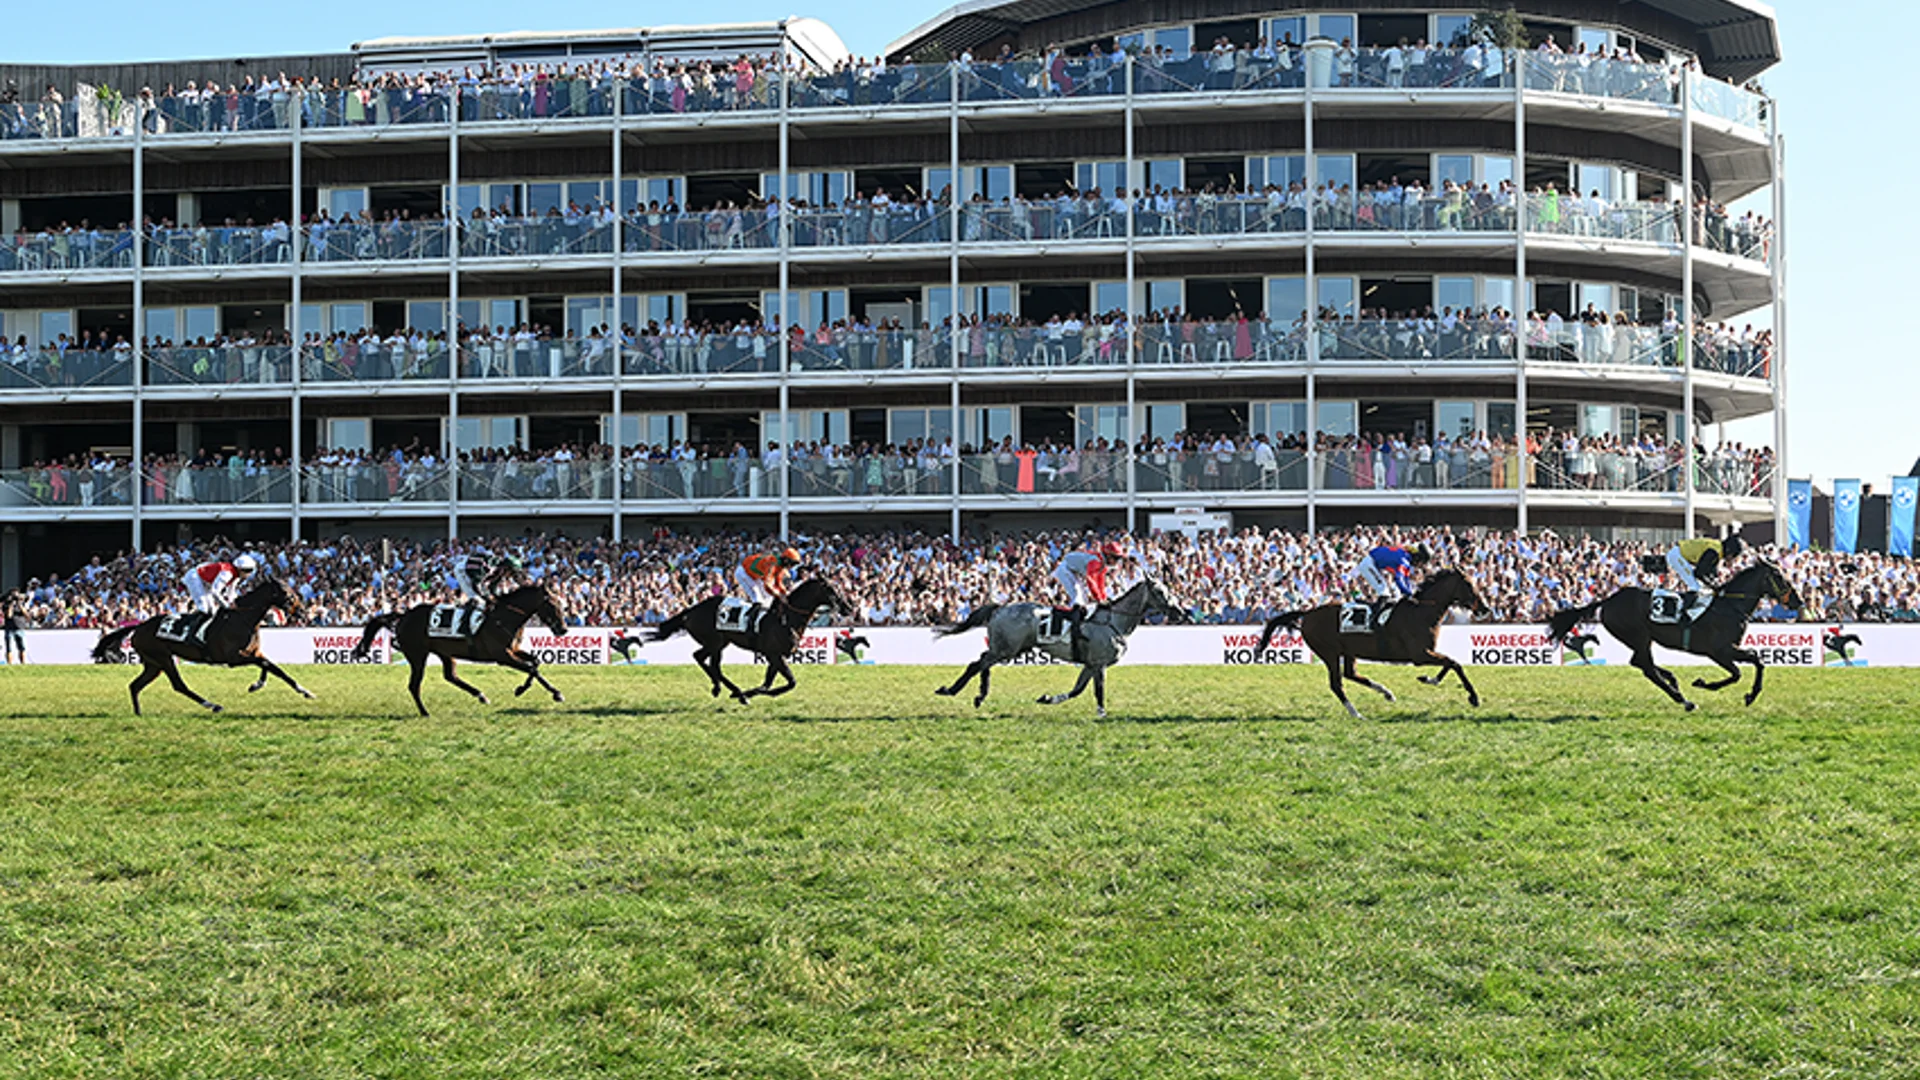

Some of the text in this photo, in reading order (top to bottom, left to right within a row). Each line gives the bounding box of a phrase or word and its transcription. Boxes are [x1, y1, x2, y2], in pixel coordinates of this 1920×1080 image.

[1652, 597, 1665, 615] 3
[430, 609, 443, 628] 6
[1341, 609, 1354, 626] 2
[1040, 617, 1051, 637] 1
[529, 636, 602, 648] WAREGEM
[1223, 635, 1304, 648] WARGEM
[1470, 634, 1553, 647] WAREGEM
[1744, 634, 1814, 646] AREGEM
[1472, 649, 1553, 664] KOERSE
[1749, 649, 1813, 664] ERSE
